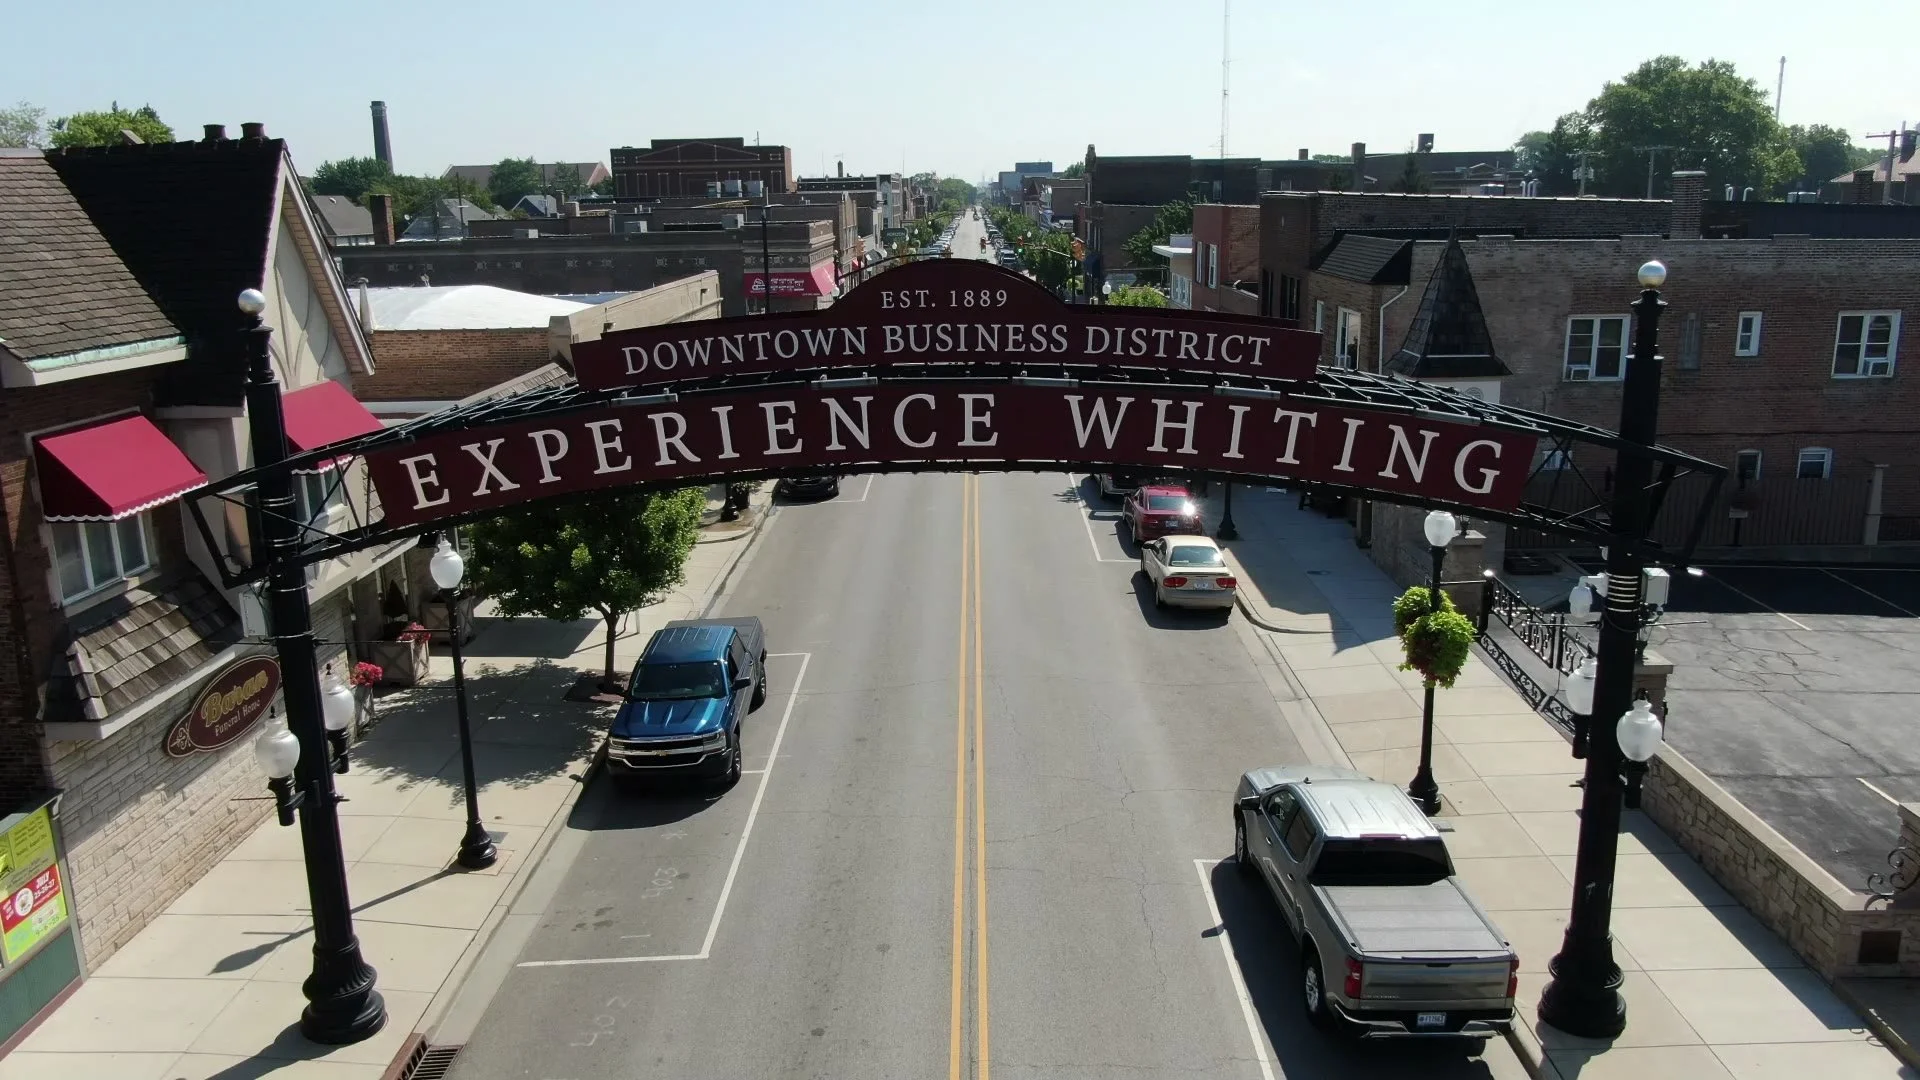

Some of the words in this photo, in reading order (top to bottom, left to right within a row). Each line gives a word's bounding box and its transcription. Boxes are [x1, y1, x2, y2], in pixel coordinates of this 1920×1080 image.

[881, 290, 936, 309] EST.
[950, 289, 1008, 309] 1889
[622, 324, 868, 376] DOWNTOWN
[882, 322, 1069, 354] BUSINESS
[1083, 324, 1272, 368] DISTRICT
[398, 393, 1001, 511] EXPERIENCE
[1062, 393, 1504, 496] WHITING
[201, 670, 269, 728] Baran
[214, 710, 242, 738] Funeral
[243, 699, 261, 717] Home
